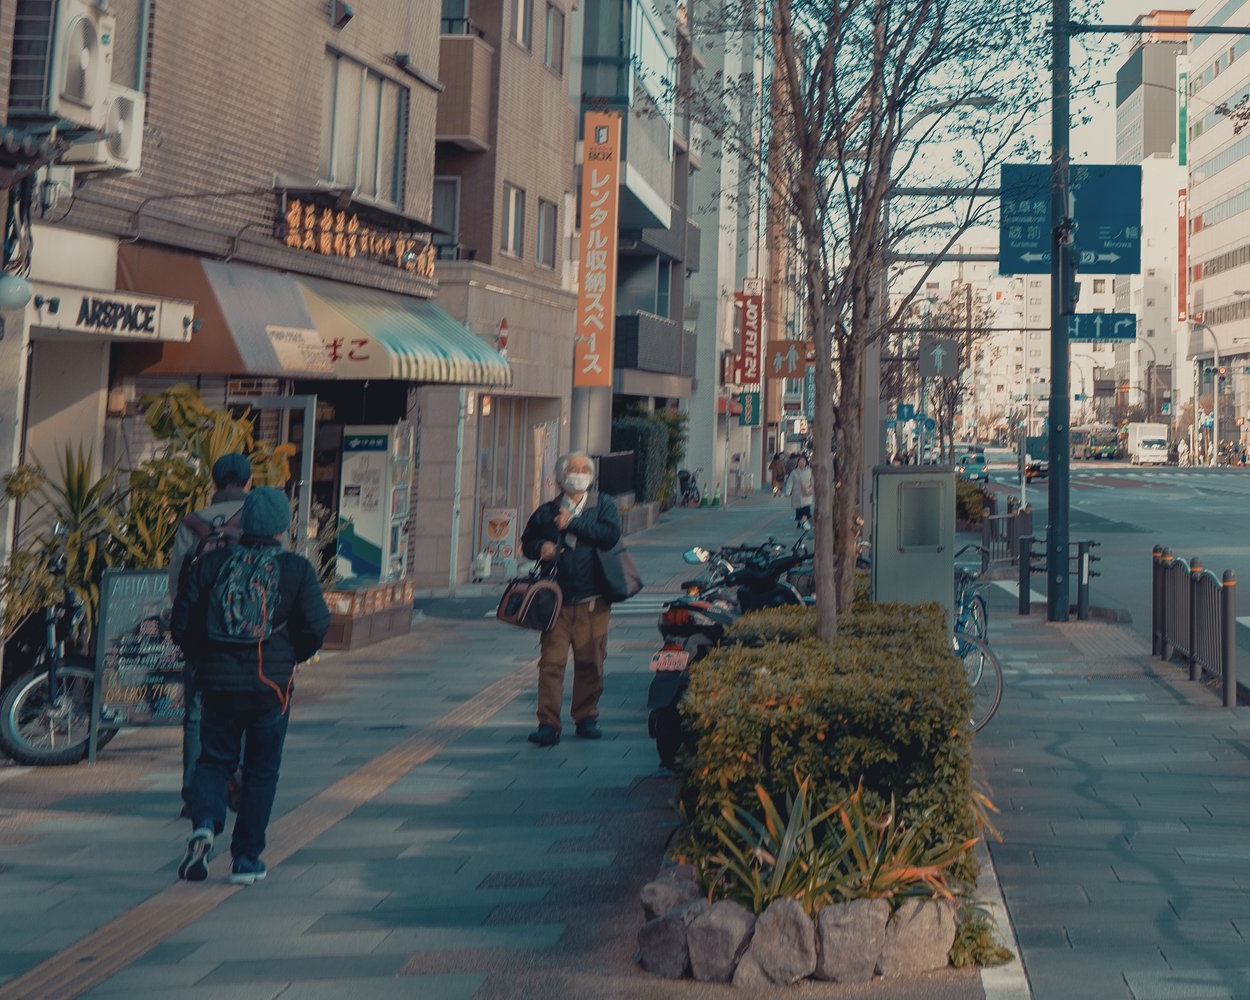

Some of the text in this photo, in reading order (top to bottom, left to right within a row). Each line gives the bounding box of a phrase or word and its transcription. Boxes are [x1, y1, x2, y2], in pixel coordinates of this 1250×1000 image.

[588, 151, 613, 161] BOX
[1008, 226, 1042, 240] 蔵前
[1098, 226, 1139, 240] 三ノ輪
[1104, 241, 1132, 249] Minowa
[582, 168, 611, 374] レンタル収納スペース
